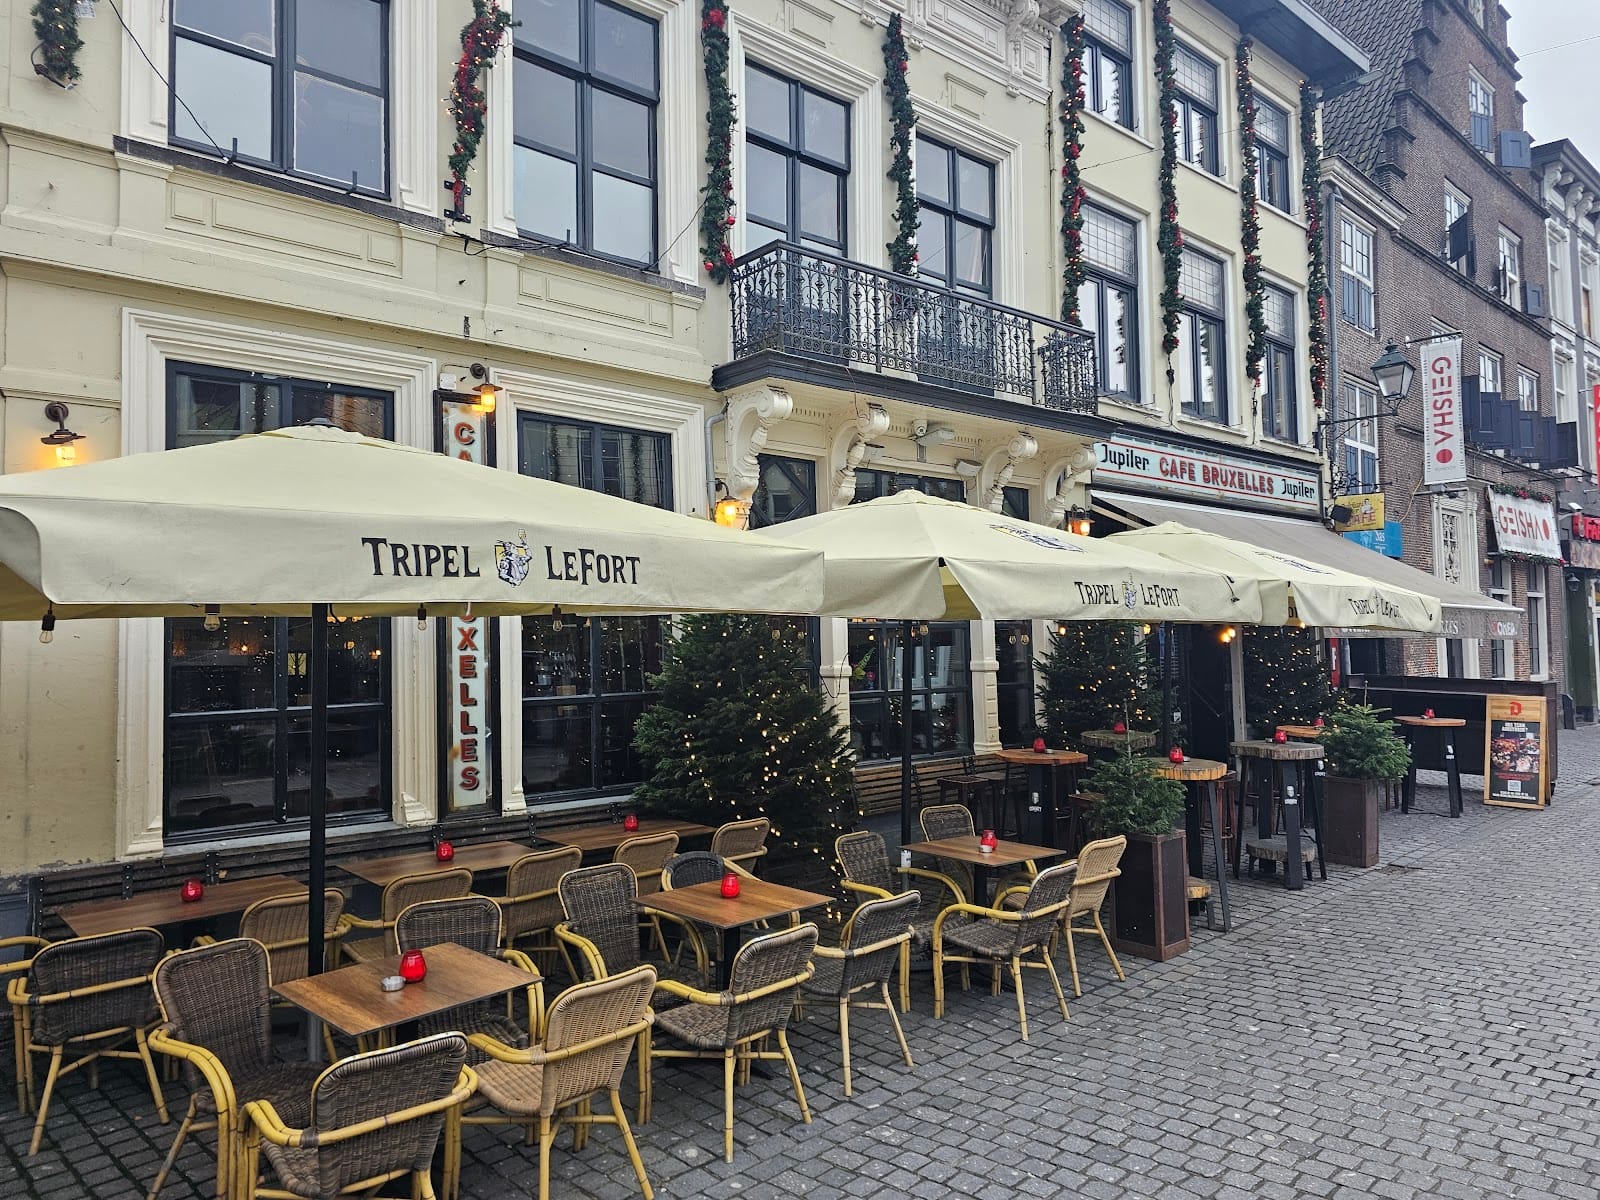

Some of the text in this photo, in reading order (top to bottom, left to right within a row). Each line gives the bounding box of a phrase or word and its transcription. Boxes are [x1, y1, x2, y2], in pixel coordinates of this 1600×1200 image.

[1431, 356, 1454, 446] GEISHA
[1100, 443, 1315, 500] Jupiler CAFE BRUXELLES Jupiler
[1498, 505, 1543, 541] GEISHA
[361, 537, 481, 578] TRIPEL
[1073, 581, 1119, 605] TRIPEL
